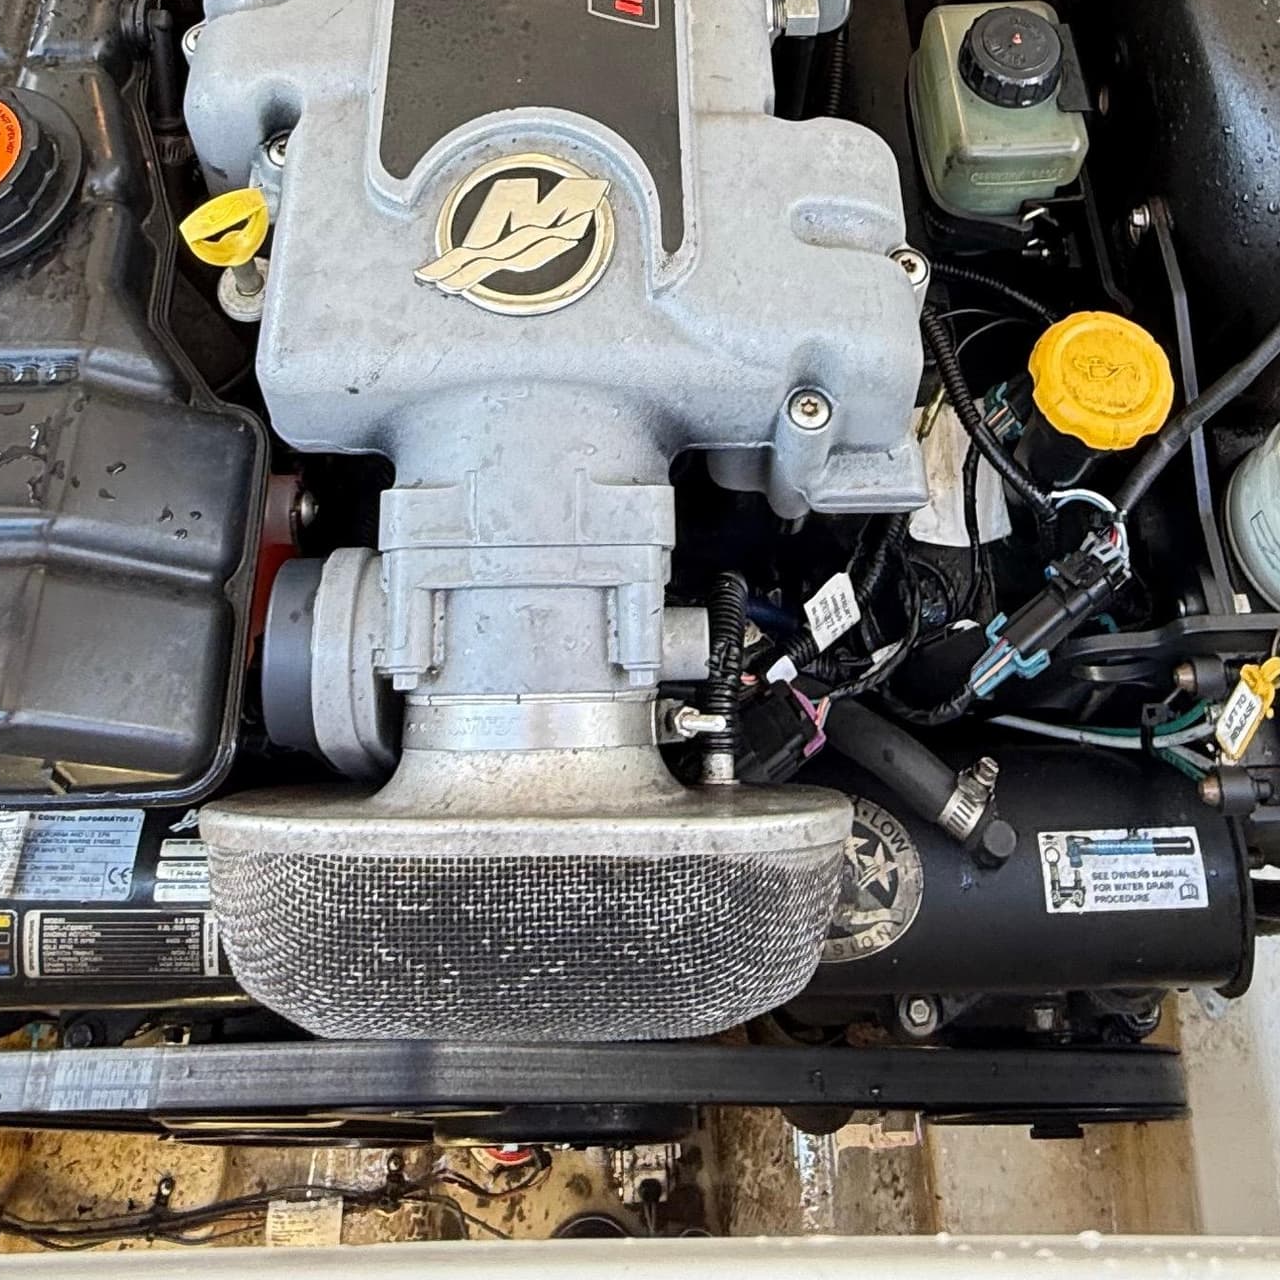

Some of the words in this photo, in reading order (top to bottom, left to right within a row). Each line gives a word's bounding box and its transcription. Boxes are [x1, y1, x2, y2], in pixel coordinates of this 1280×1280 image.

[38, 814, 76, 822] CONTROL
[78, 815, 134, 823] INFORMATION
[871, 811, 909, 853] LOW
[1092, 871, 1109, 880] SEE
[1093, 883, 1111, 891] FOR
[1114, 882, 1144, 891] WATER
[1146, 881, 1174, 890] DRAIN
[1094, 894, 1150, 903] PROCEDURE
[821, 924, 892, 957] SION
